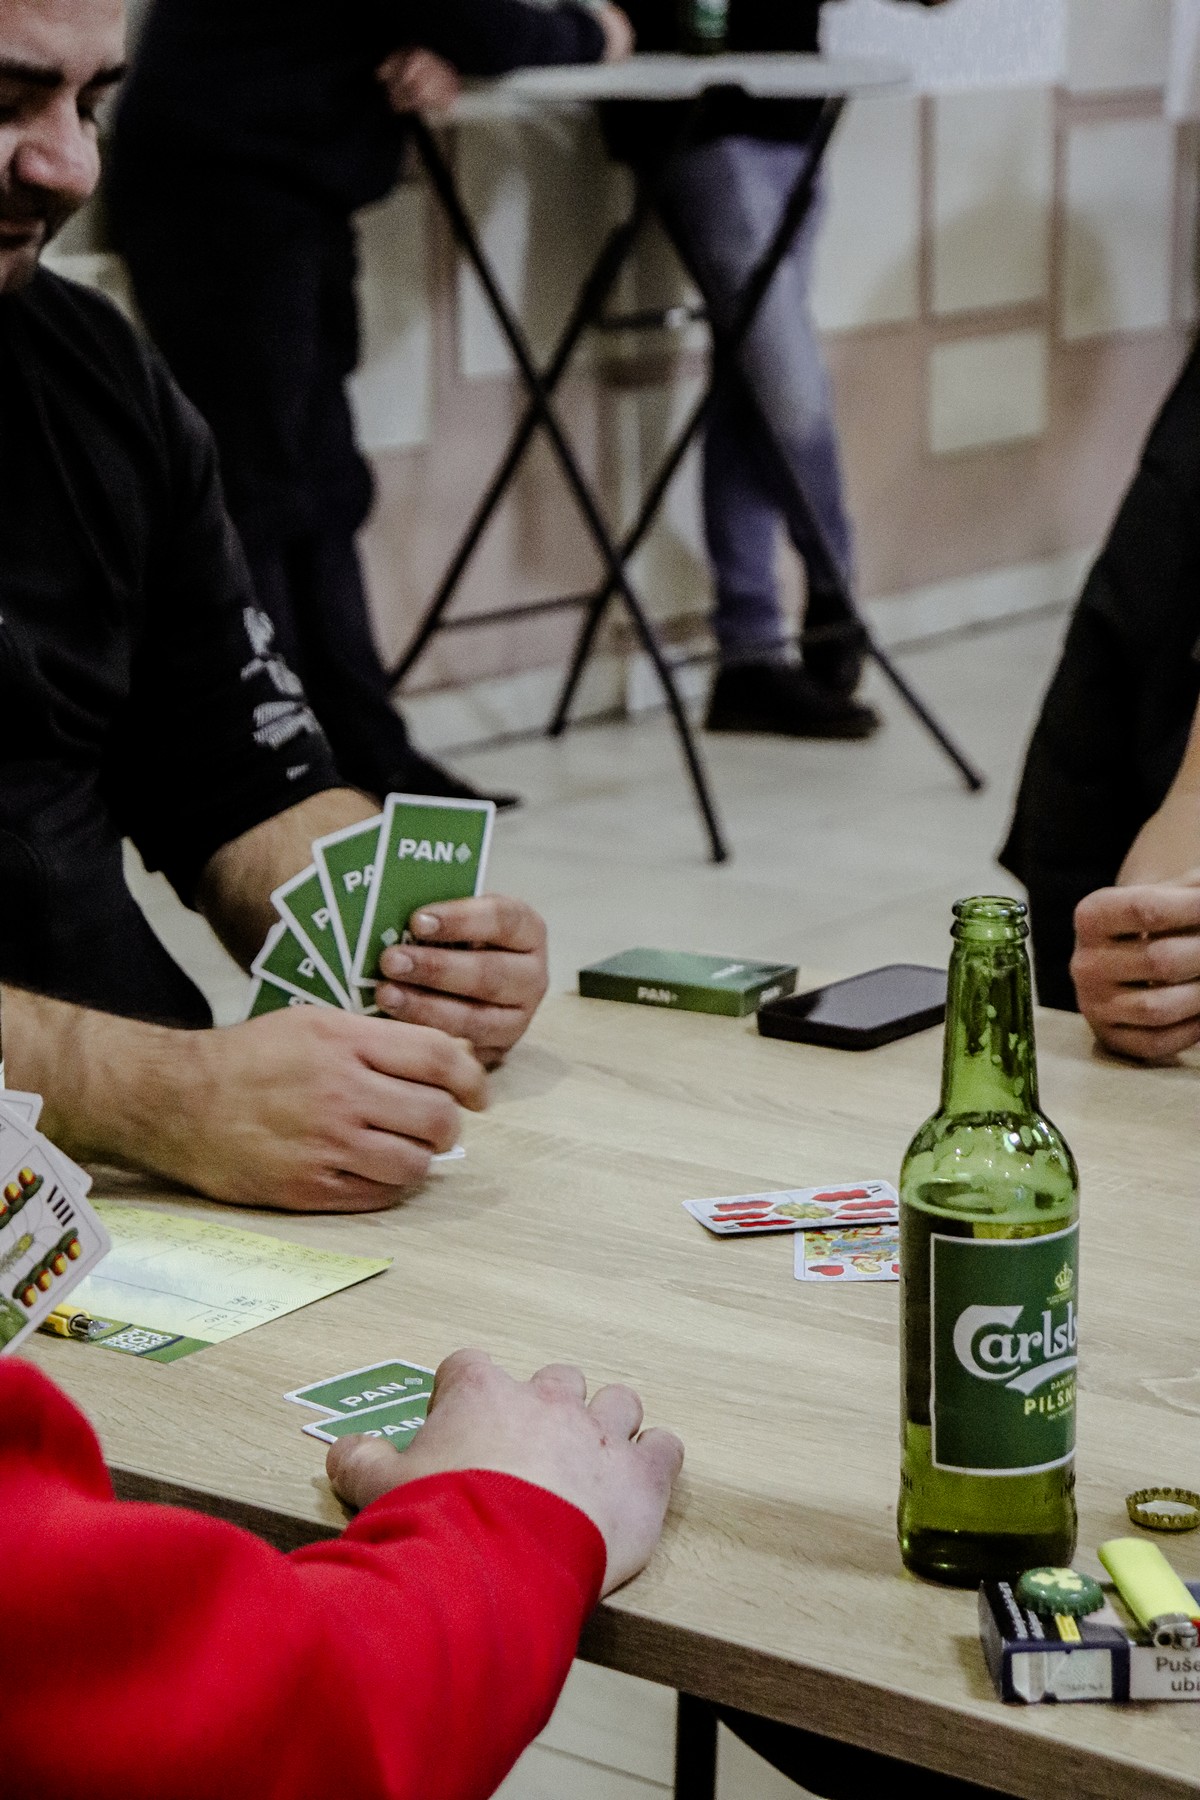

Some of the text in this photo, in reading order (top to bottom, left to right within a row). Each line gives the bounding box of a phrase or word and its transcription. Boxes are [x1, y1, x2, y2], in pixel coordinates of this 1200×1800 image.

[398, 838, 455, 864] PAN
[343, 864, 376, 893] PA
[46, 1185, 75, 1227] VIII
[339, 1382, 408, 1408] PAN
[1024, 1383, 1077, 1416] PILSN
[363, 1416, 426, 1439] PAN
[1156, 1656, 1200, 1672] Puše
